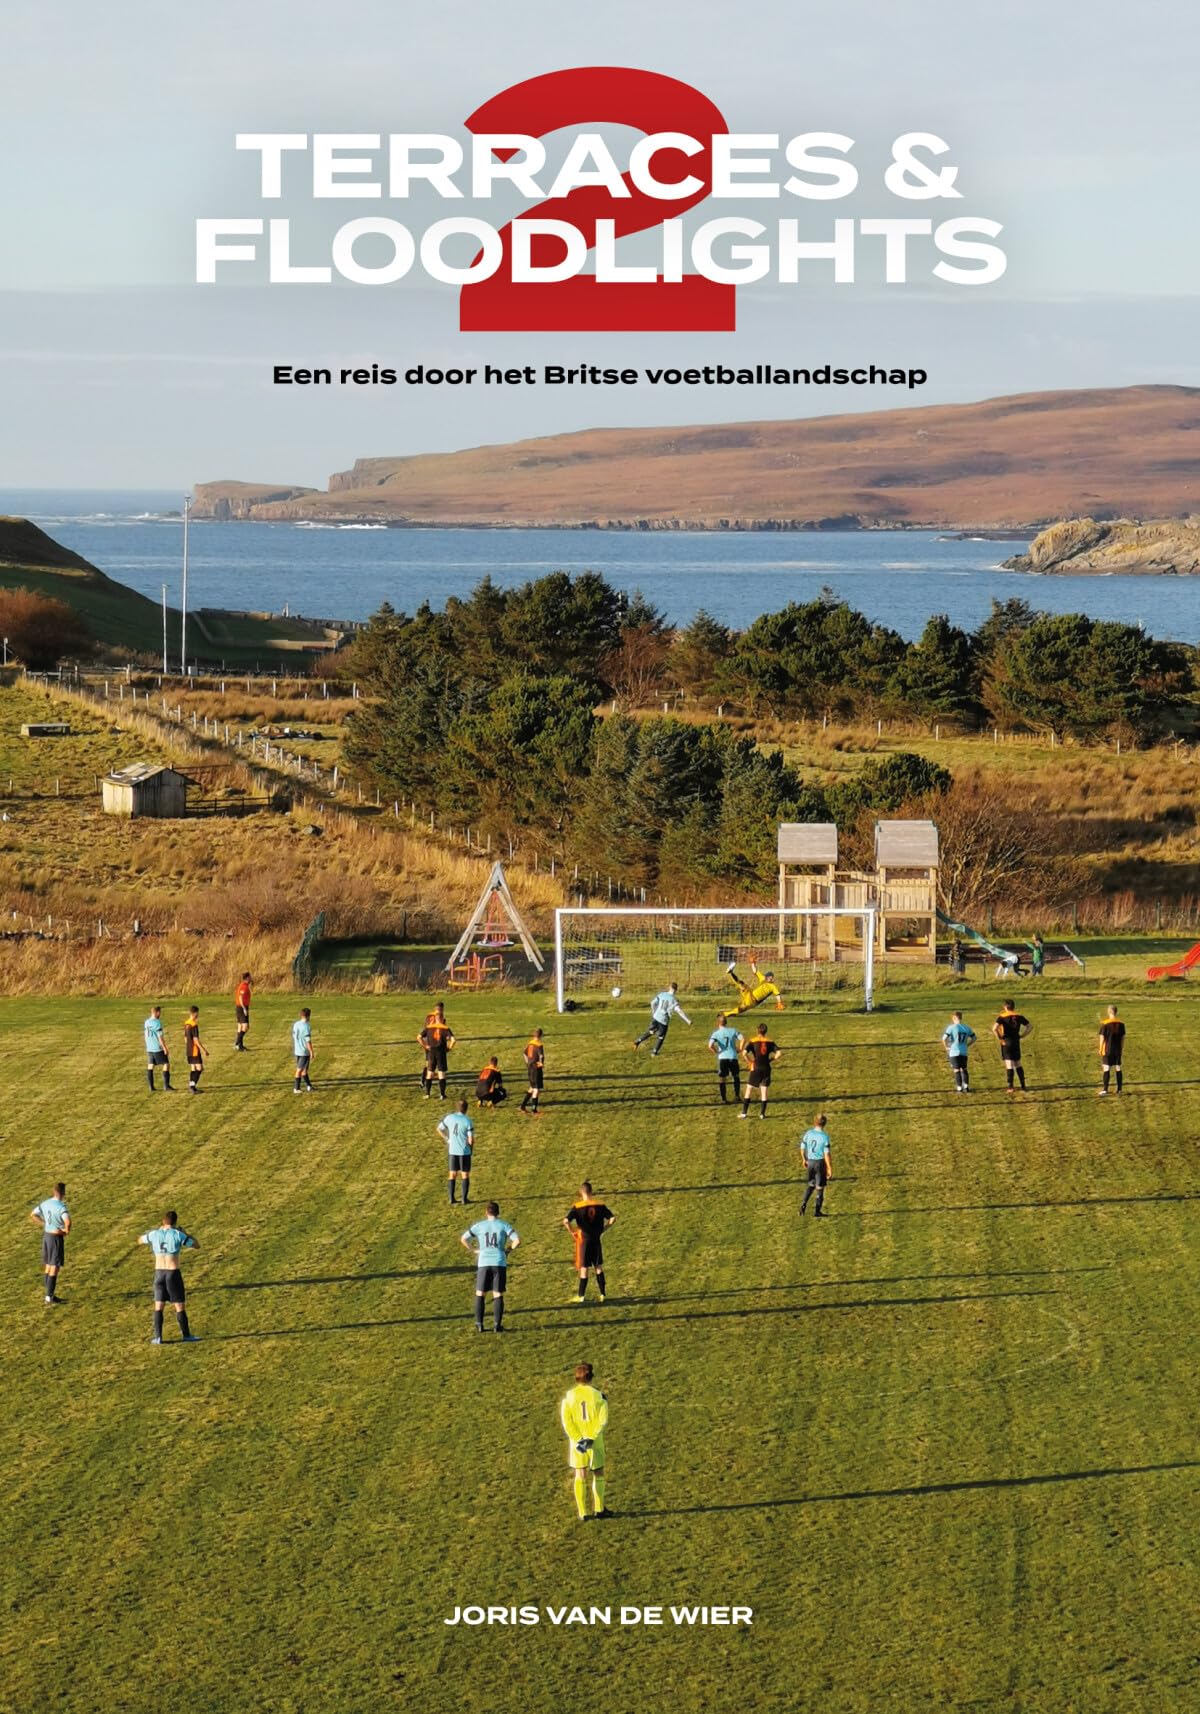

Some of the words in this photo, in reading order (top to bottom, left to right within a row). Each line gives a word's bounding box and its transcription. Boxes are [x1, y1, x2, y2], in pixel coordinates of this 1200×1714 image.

[452, 1122, 459, 1137] 4
[810, 1139, 818, 1153] 2
[484, 1231, 500, 1249] 14
[580, 1400, 589, 1421] 1
